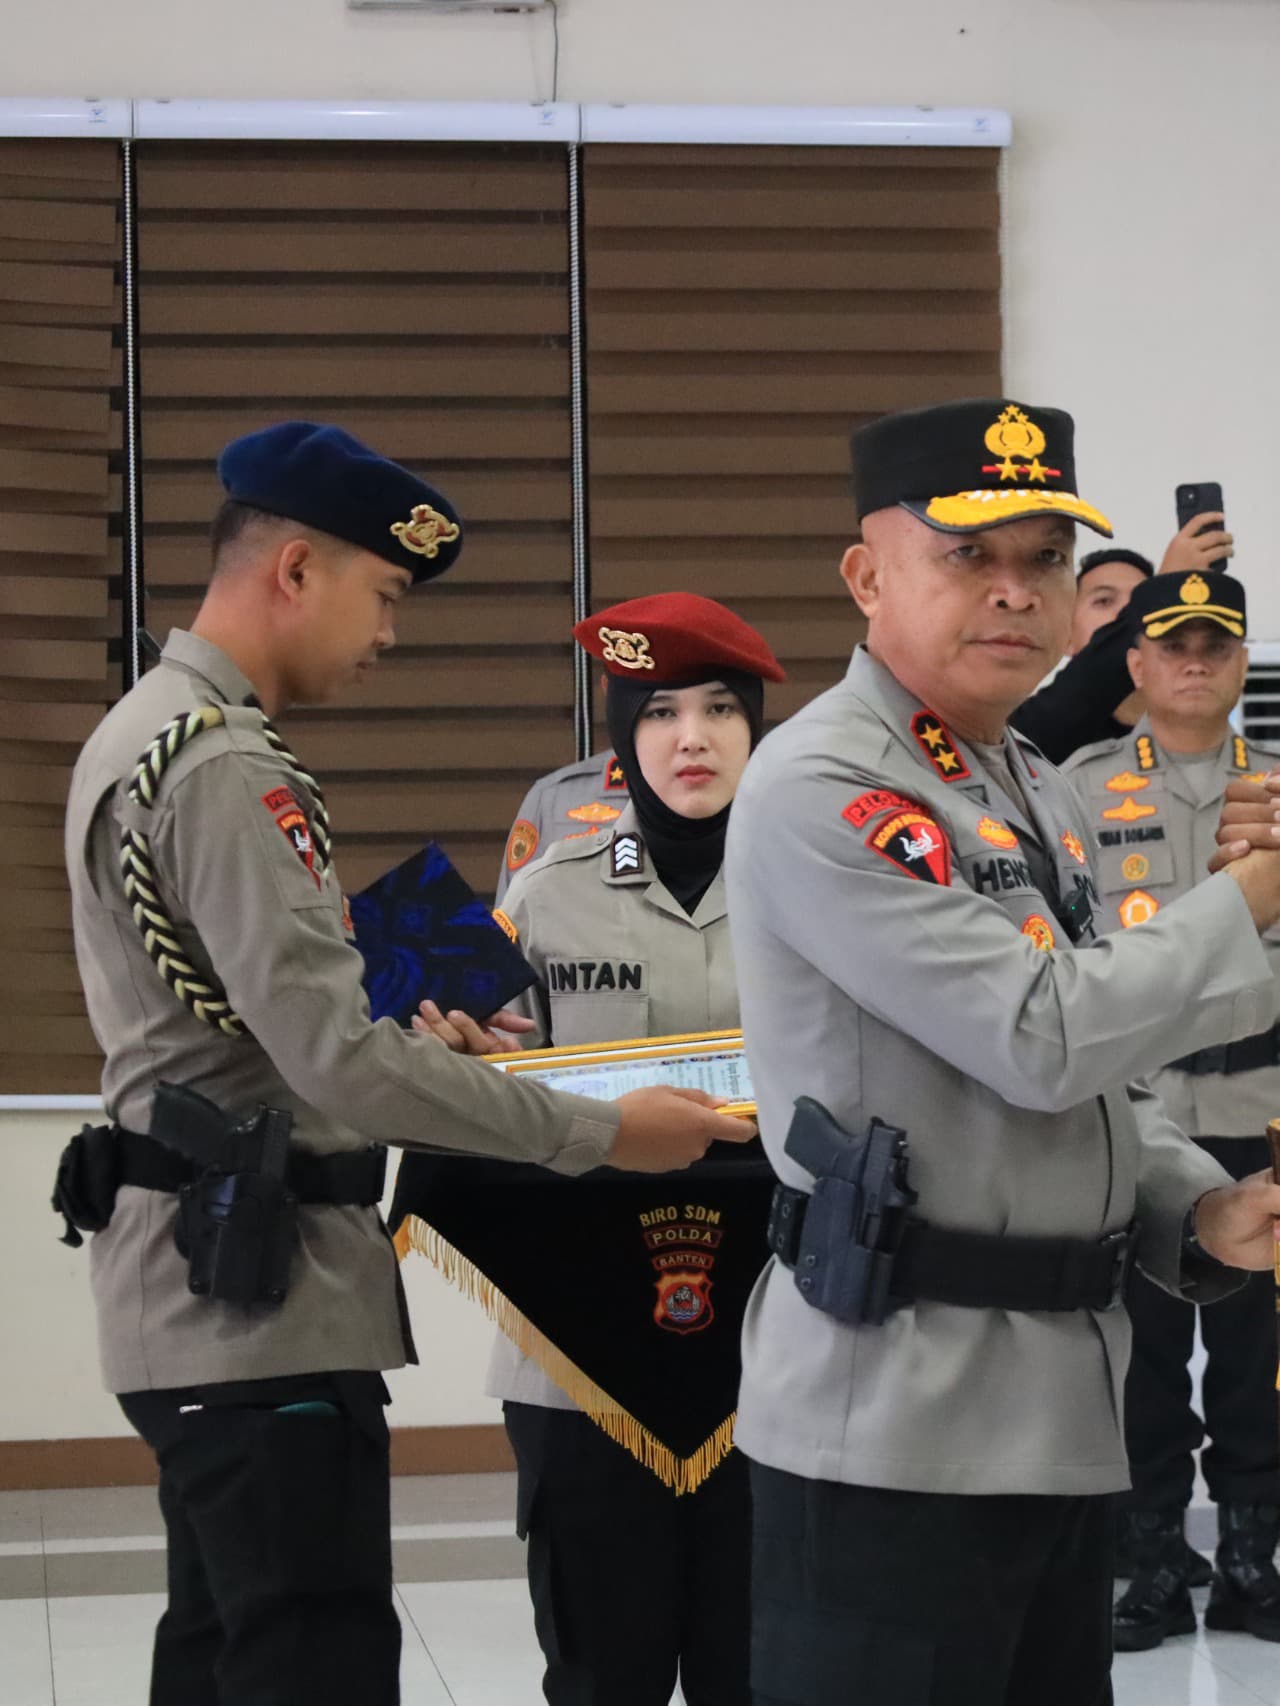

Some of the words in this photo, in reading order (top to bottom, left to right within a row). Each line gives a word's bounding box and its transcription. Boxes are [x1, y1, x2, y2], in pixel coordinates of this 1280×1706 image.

[550, 962, 642, 991] INTAN
[639, 1205, 678, 1227] BIRO
[684, 1204, 721, 1224] SDM
[652, 1228, 712, 1244] POLDA
[659, 1253, 707, 1267] BANTEN
